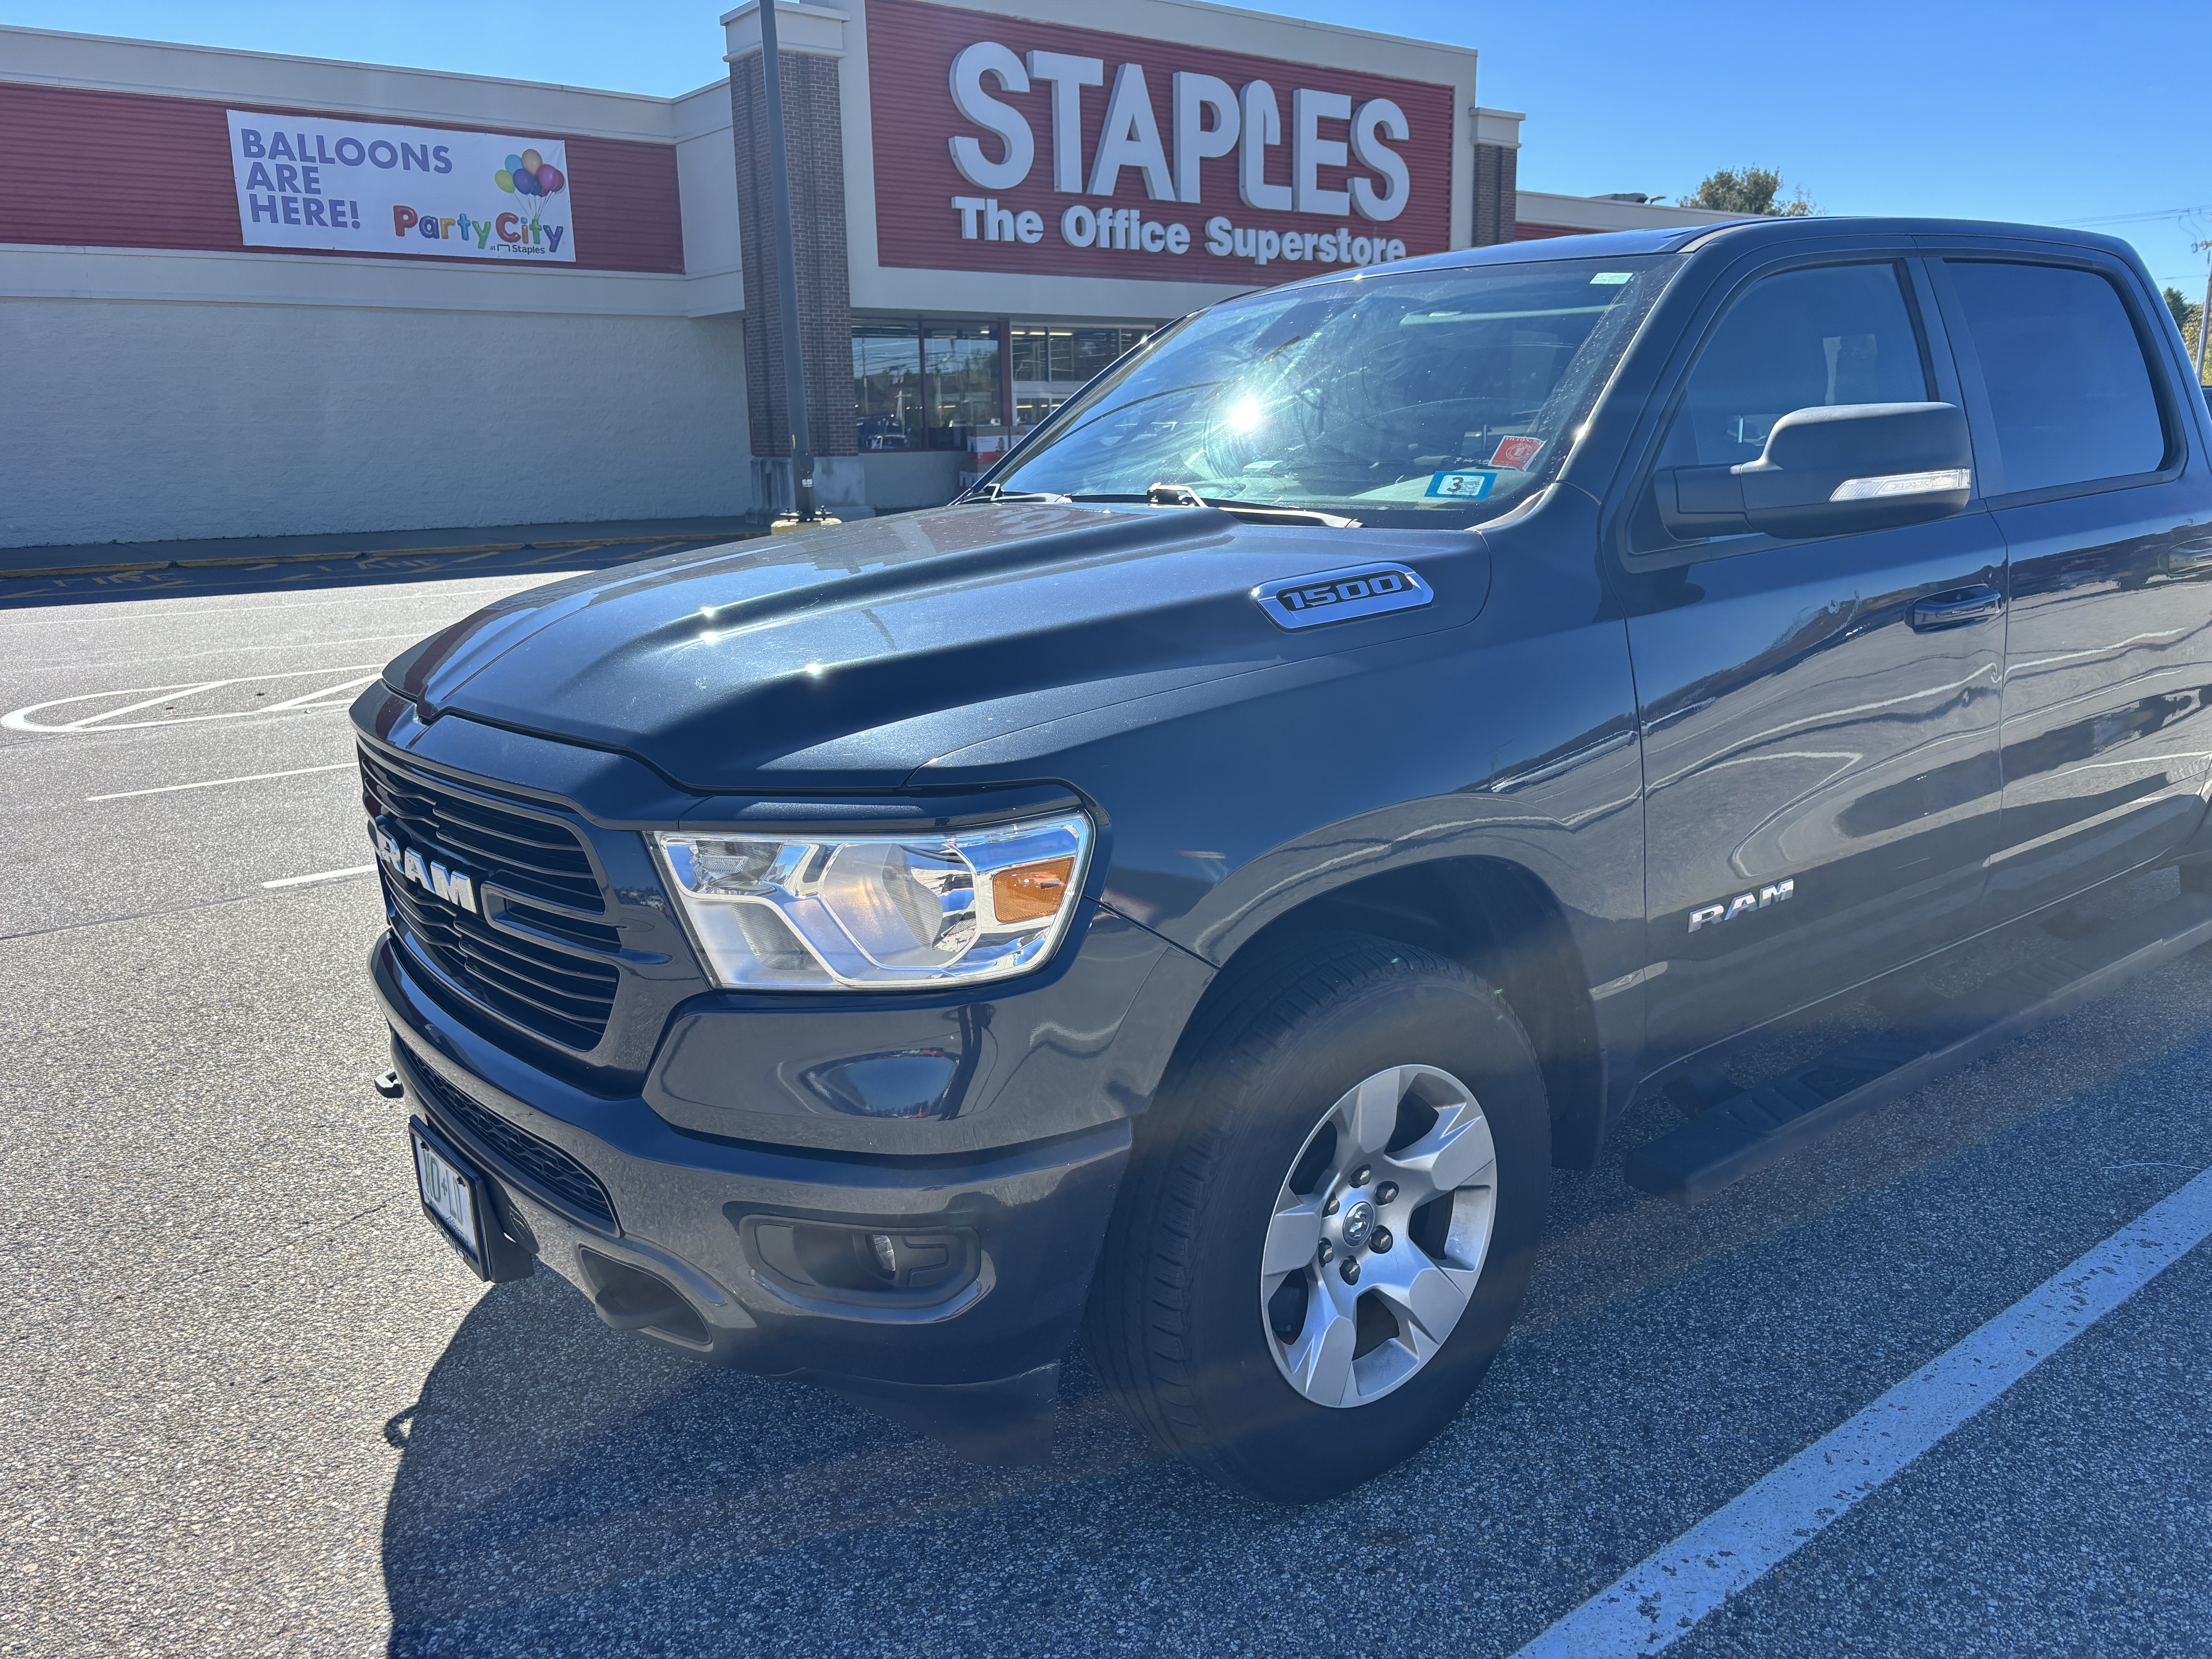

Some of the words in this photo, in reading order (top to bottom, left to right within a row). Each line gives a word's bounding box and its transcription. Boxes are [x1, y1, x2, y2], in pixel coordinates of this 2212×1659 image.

[240, 128, 453, 174] BALLOONS
[948, 41, 1410, 222] STAPLES
[246, 161, 321, 195] ARE
[249, 194, 361, 229] HERE!
[393, 205, 491, 249] Party
[495, 212, 564, 252] City
[951, 196, 1044, 244] The
[1061, 205, 1191, 254] Office
[1205, 216, 1406, 266] Superstore
[512, 244, 545, 255] Staples
[1447, 477, 1464, 492] 3
[1282, 575, 1402, 608] 1500
[376, 825, 478, 914] RAM
[1688, 878, 1794, 933] RAM
